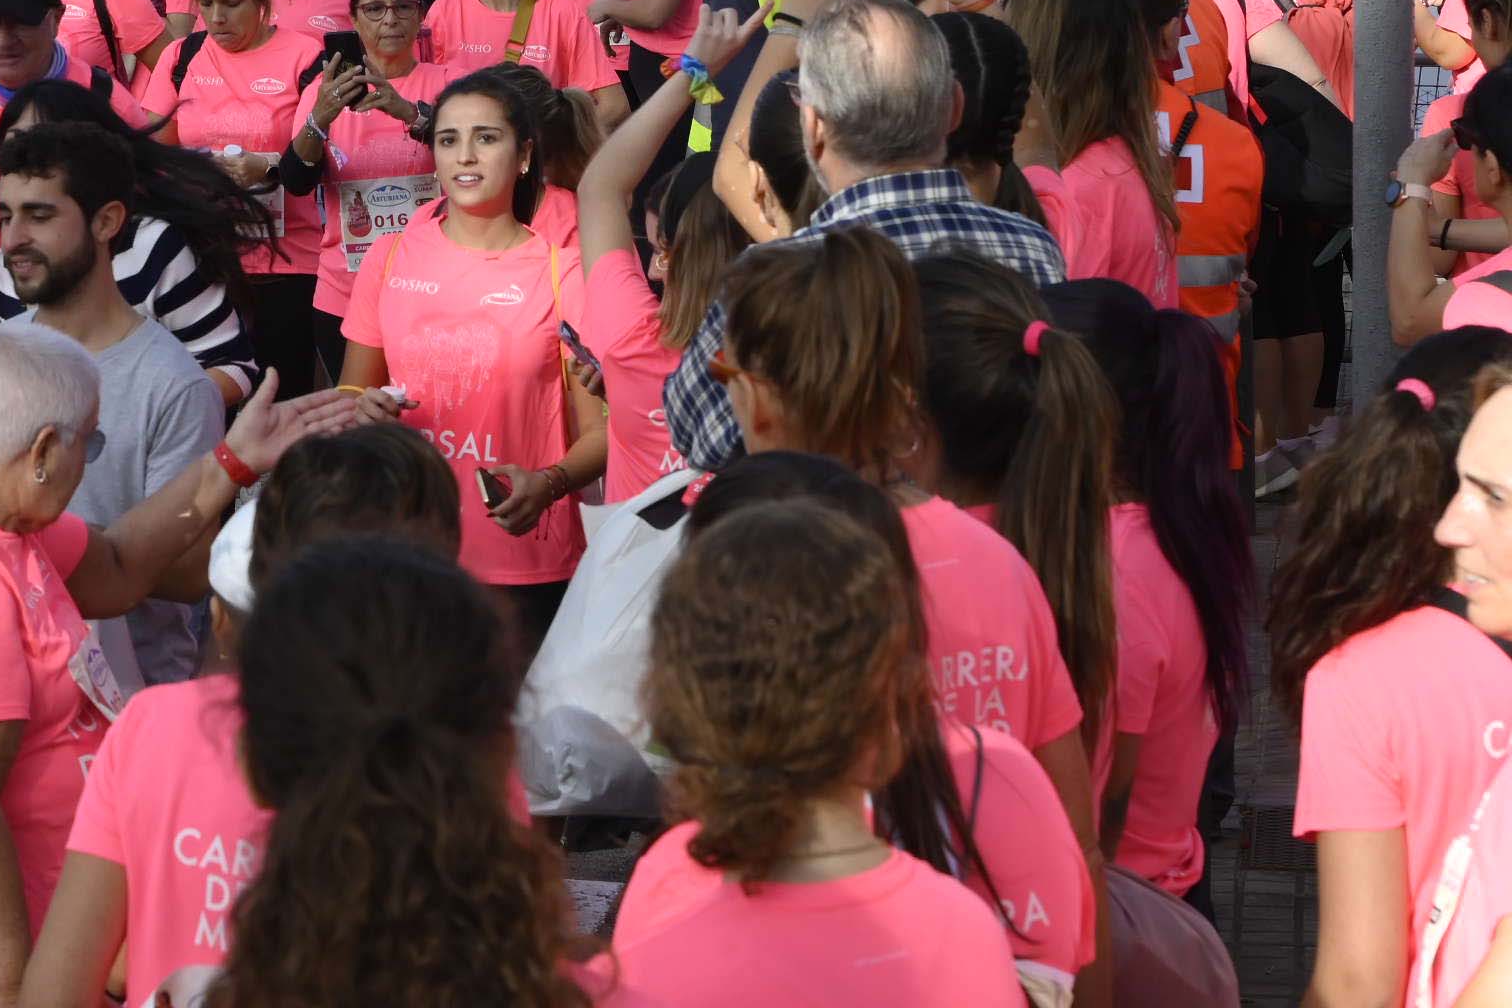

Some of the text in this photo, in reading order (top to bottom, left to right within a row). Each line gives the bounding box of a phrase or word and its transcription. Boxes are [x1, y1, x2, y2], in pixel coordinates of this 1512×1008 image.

[374, 212, 409, 229] 016
[389, 276, 441, 296] OYSHO
[174, 828, 256, 876] CAR
